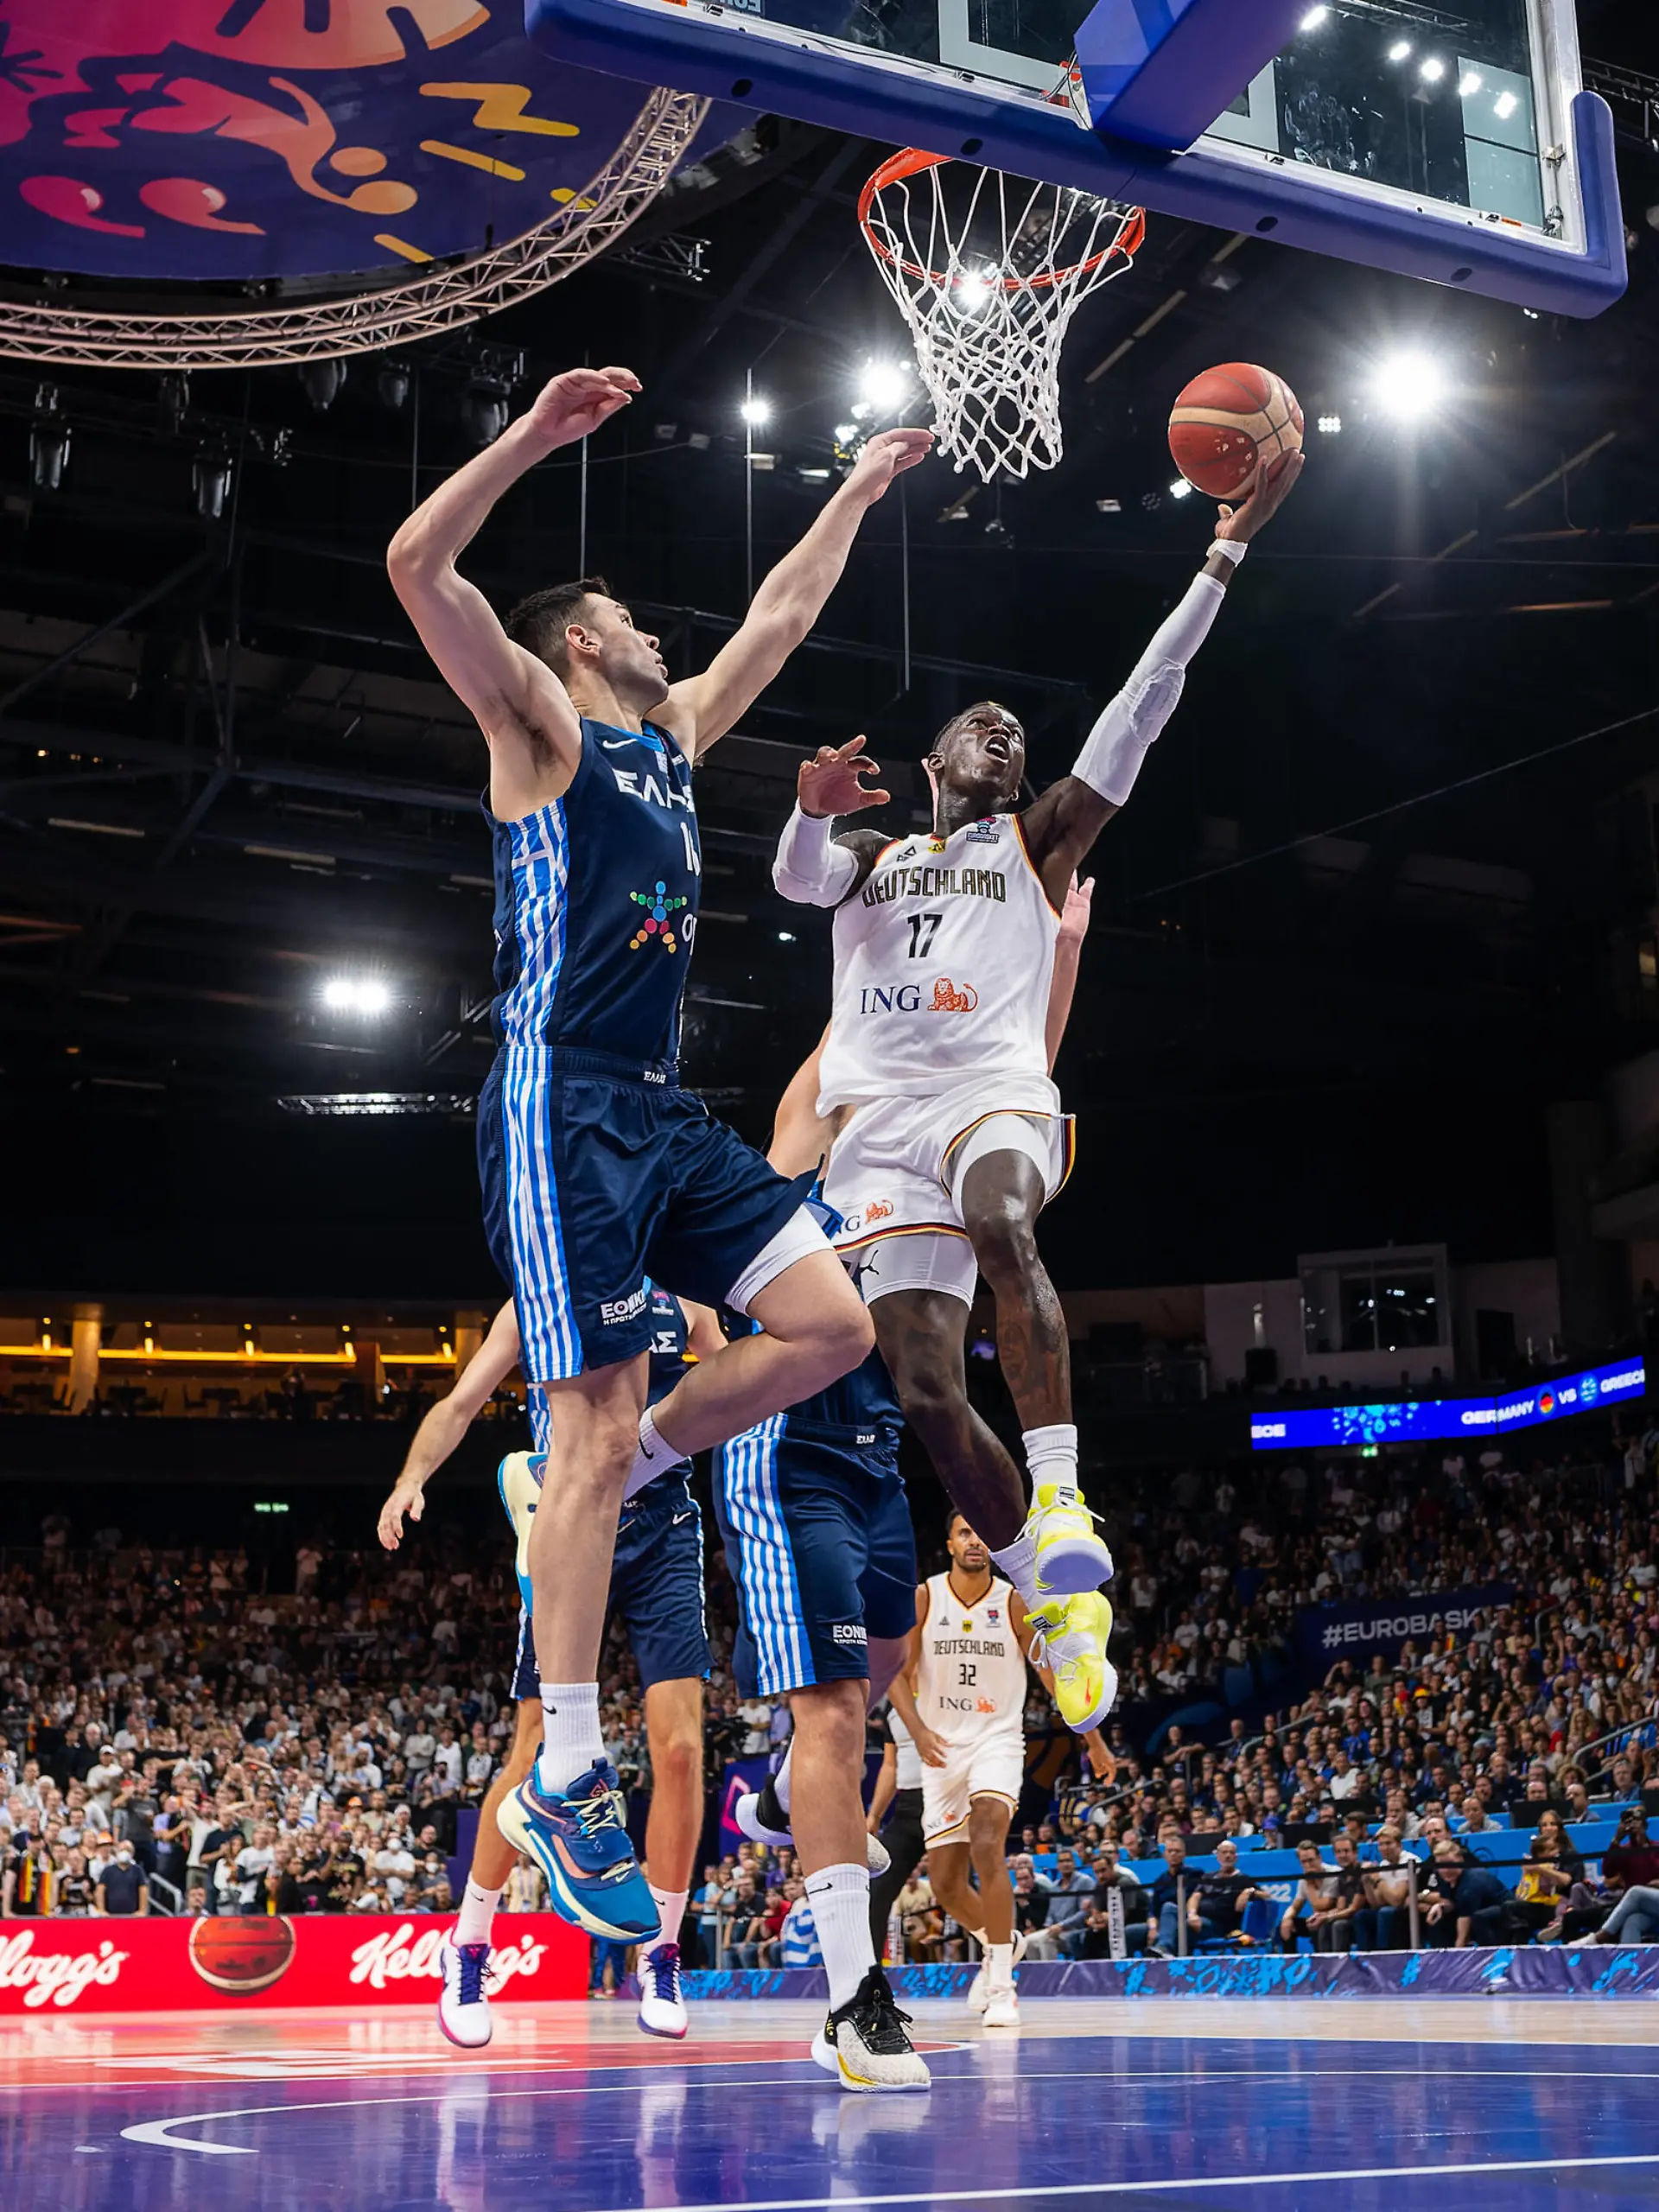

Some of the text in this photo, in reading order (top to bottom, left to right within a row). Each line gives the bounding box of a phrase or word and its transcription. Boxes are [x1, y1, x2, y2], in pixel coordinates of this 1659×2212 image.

[862, 866, 1006, 907] DEUTSCHLAND
[907, 913, 943, 958] 17
[861, 984, 921, 1014] ING
[1461, 1399, 1535, 1425] GERMANY
[933, 1639, 1004, 1657] DEUTSCHLAND
[958, 1663, 976, 1686] 32
[938, 1696, 972, 1712] ING
